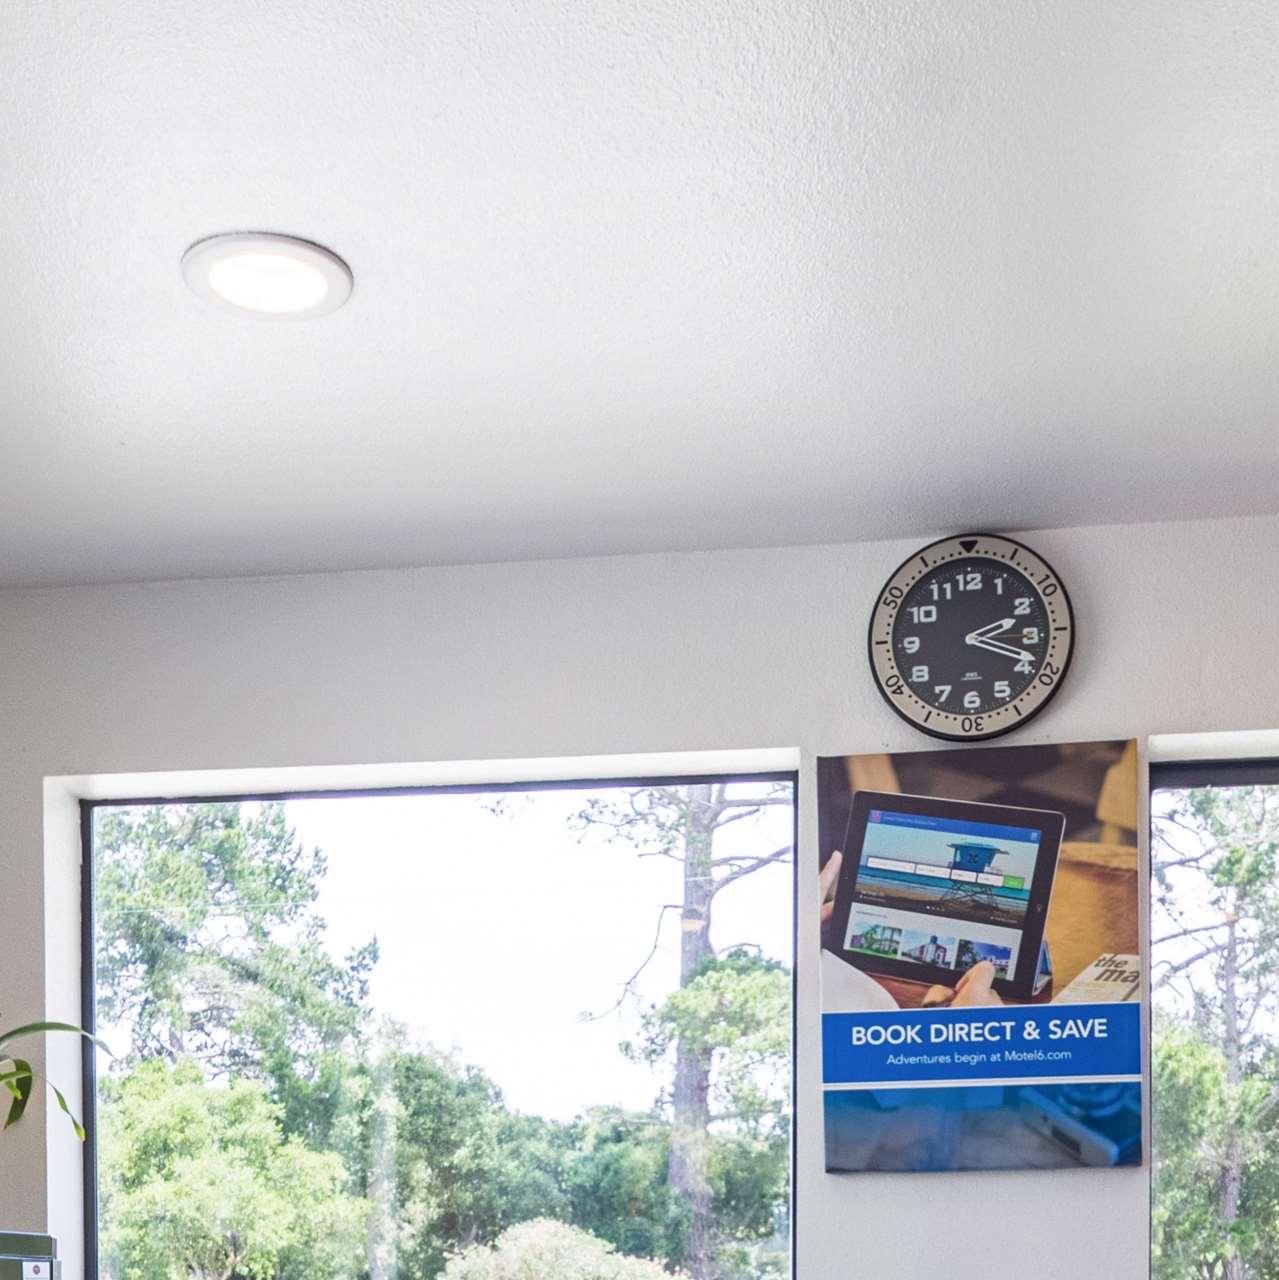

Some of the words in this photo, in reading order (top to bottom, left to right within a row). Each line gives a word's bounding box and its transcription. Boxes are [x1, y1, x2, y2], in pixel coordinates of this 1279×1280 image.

[956, 573, 982, 591] 12
[993, 578, 1003, 594] 1
[930, 582, 952, 600] 11
[907, 605, 937, 623] 10
[1014, 598, 1031, 615] 2
[1022, 627, 1039, 644] 3
[903, 636, 920, 653] 9
[912, 665, 929, 682] 8
[934, 685, 952, 702] 7
[993, 680, 1011, 697] 5
[963, 691, 980, 708] 6
[1094, 953, 1128, 969] the
[851, 1025, 922, 1045] BOOK
[930, 1021, 1015, 1043] DIRECT
[1022, 1022, 1040, 1040] &
[1049, 1019, 1108, 1040] SAVE
[887, 1053, 951, 1065] Adventures
[955, 1051, 986, 1065] begin
[990, 1051, 1001, 1062] at
[1004, 1049, 1072, 1061] Motel6.com
